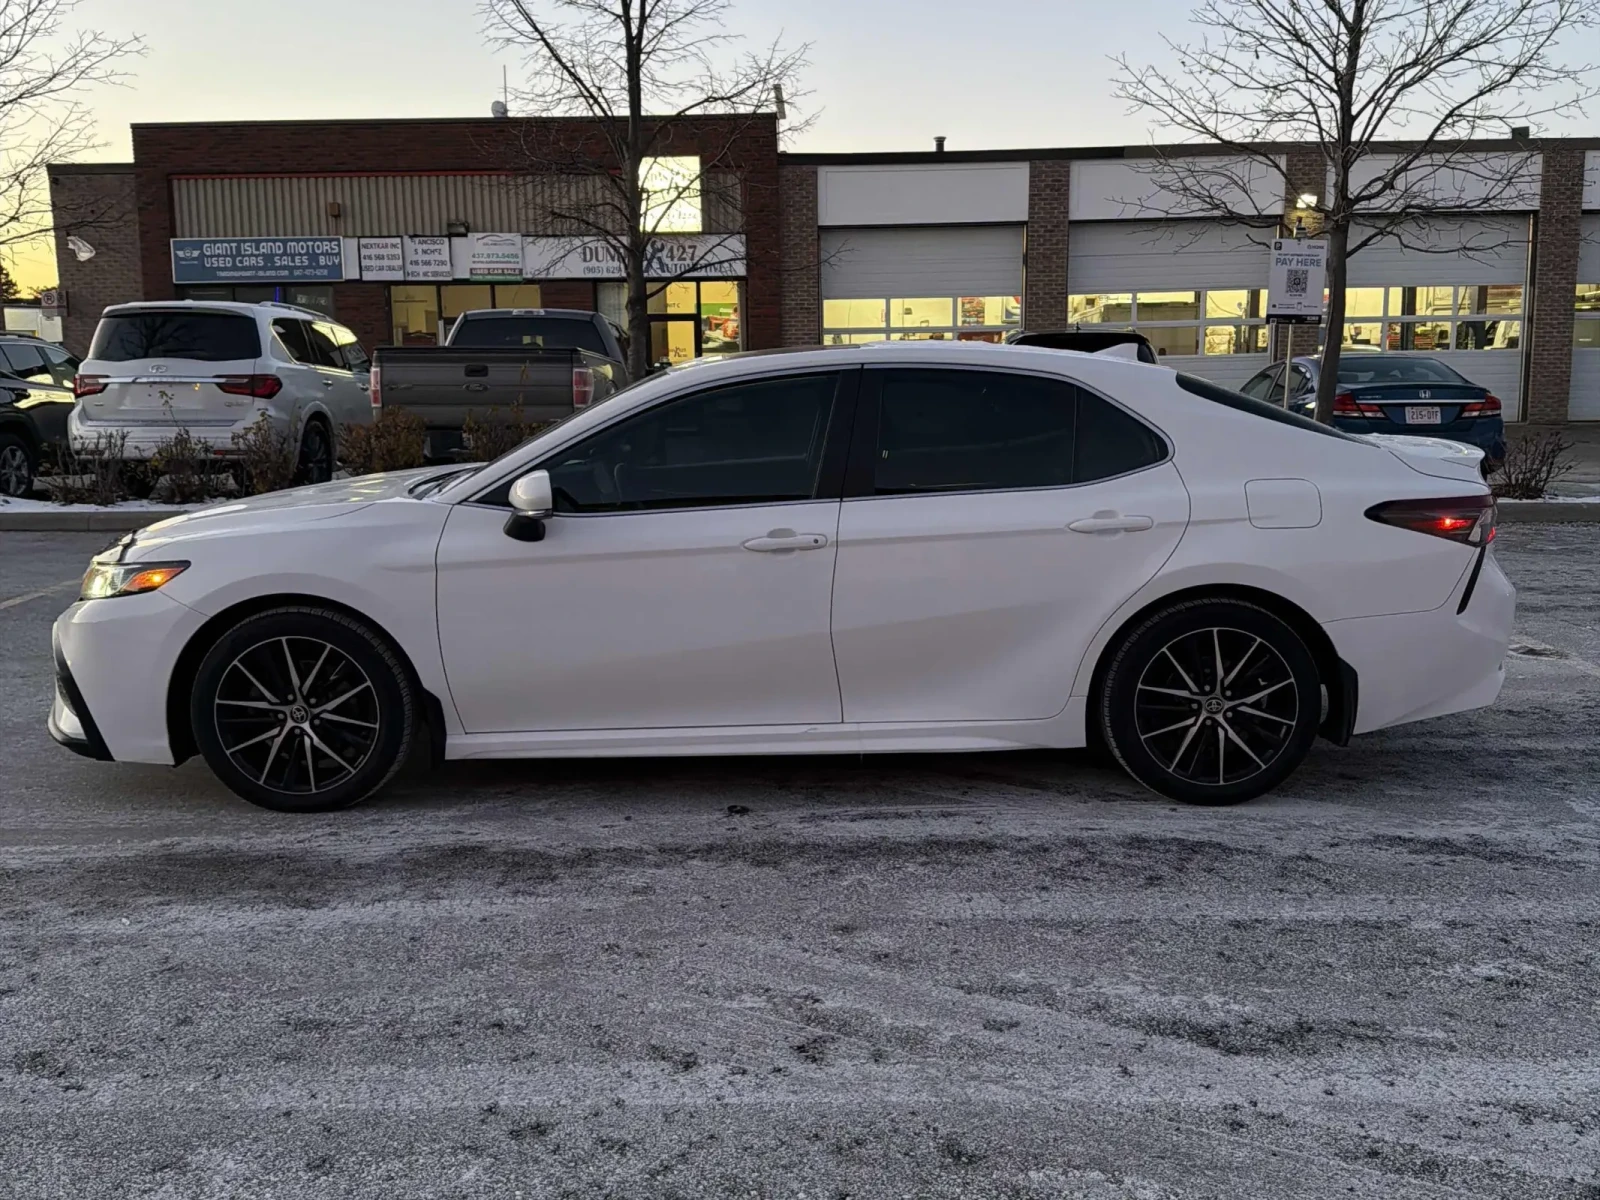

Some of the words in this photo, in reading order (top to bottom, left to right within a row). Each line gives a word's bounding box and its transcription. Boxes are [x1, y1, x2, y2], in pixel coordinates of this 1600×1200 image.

[203, 243, 237, 255] GIANT
[240, 242, 283, 255] ISLAND
[287, 241, 339, 254] MOTORS
[361, 242, 388, 250] NEXTKAR
[390, 242, 400, 250] INC
[414, 248, 443, 256] SNCHEZ
[666, 244, 697, 261] 427
[204, 257, 232, 267] USED
[236, 256, 264, 267] CARS
[274, 256, 309, 266] SALES
[319, 255, 340, 266] BUY
[1275, 257, 1294, 266] PAY
[1296, 258, 1322, 267] HERE
[583, 265, 604, 275] (905)
